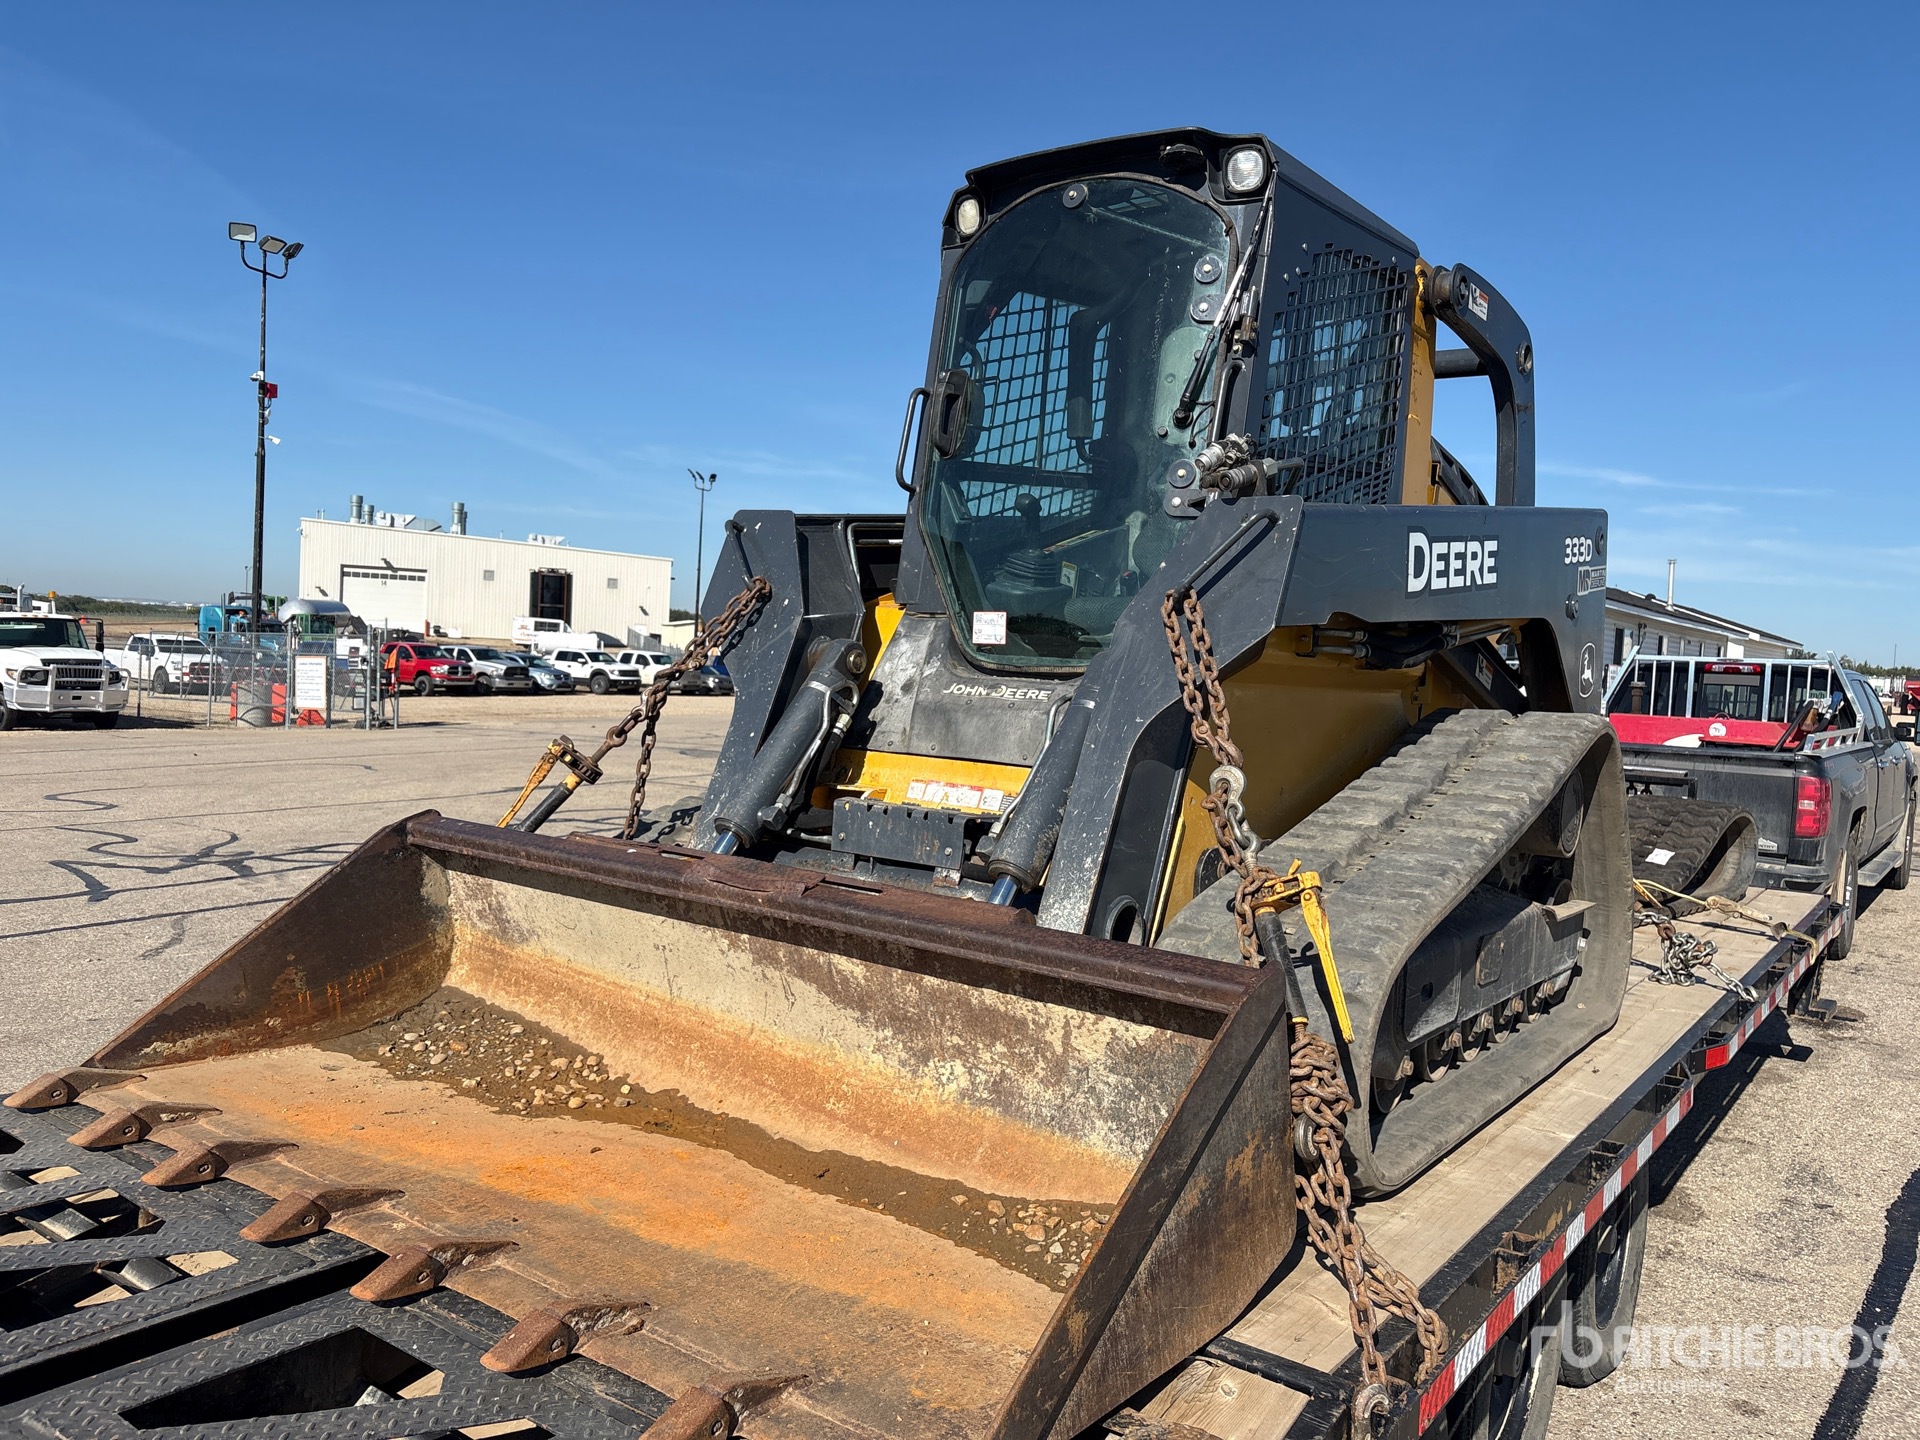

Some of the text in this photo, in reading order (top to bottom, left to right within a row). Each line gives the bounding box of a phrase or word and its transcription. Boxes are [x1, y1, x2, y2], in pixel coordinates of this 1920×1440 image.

[1407, 532, 1498, 592] DEERE
[1564, 536, 1593, 564] 333D
[943, 683, 1051, 700] JOHN DEERE
